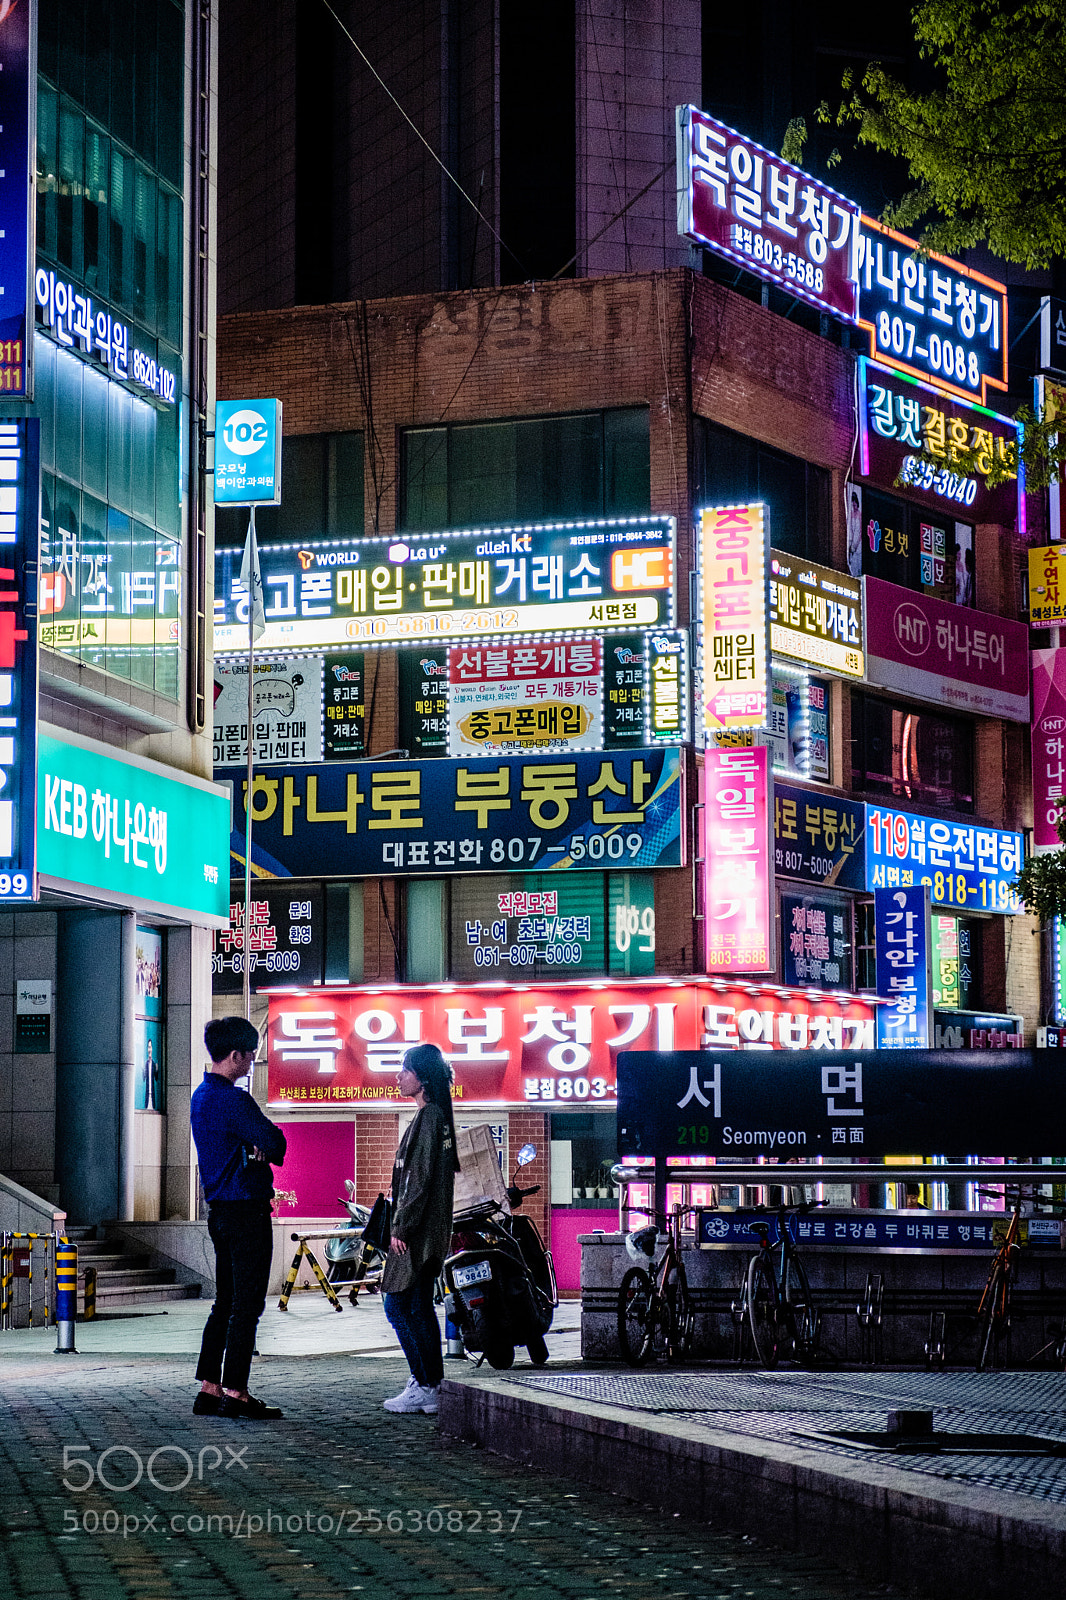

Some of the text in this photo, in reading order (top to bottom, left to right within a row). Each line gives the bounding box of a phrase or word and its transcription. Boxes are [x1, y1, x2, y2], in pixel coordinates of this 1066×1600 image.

[692, 121, 860, 283] 독일보청기
[754, 231, 824, 292] 803-5588
[35, 268, 177, 405] 이안과의원 8620-102
[877, 311, 981, 387] 807-0088
[867, 383, 923, 448] 길벗
[224, 424, 271, 445] 102
[218, 464, 249, 477] 굿모닝
[217, 478, 277, 491] 백이안과의원
[410, 544, 447, 560] LG U+
[511, 533, 532, 553] kt
[884, 527, 909, 557] 길벗
[922, 524, 946, 557] 결혼
[316, 551, 359, 566] WORLD
[615, 551, 665, 588] HC
[713, 508, 753, 631] 중고폰
[922, 557, 946, 586] 정보
[1043, 548, 1060, 605] 수연사
[589, 603, 637, 621] 서면점
[713, 634, 755, 658] 매입
[935, 618, 1005, 676] 하나투어
[456, 645, 596, 678] 선불폰개통
[713, 658, 755, 682] 센터
[525, 680, 599, 699] 모두 개통가능
[616, 669, 643, 685] 중고폰
[333, 686, 359, 702] 중고폰
[415, 699, 448, 715] 매입·판
[469, 704, 581, 740] 중고폰매입
[616, 707, 644, 722] 거래소
[333, 723, 359, 738] 거래소
[241, 760, 651, 836] 하나로 부동산
[45, 773, 88, 839] KEB
[92, 787, 168, 875] 하나은행
[805, 804, 856, 854] 부동산
[382, 832, 644, 868] 대표전화 807-5009
[713, 751, 761, 929] 독일보청기
[868, 810, 910, 860] 119
[927, 821, 1021, 876] 운전면허
[785, 852, 834, 877] 807-5009
[288, 900, 312, 920] 문의
[498, 890, 559, 917] 직원모집
[288, 925, 312, 945] 환영
[466, 915, 591, 945] 남·여 초보/경력
[885, 911, 919, 968] 가나안
[474, 942, 583, 966] 051-807-5009
[711, 949, 767, 965] 803-5588
[885, 976, 918, 1033] 보청기
[273, 1003, 678, 1074] 독일보청기
[309, 1085, 331, 1100] 보청기
[332, 1085, 361, 1100] 제조허가
[557, 1077, 618, 1099] 803-
[677, 1126, 864, 1150] 219 Seomyeon 西面
[799, 1222, 826, 1237] 발로
[833, 1223, 877, 1240] 건강을
[885, 1223, 898, 1239] 두
[906, 1223, 950, 1240] 바퀴로
[465, 1269, 488, 1282] 9842
